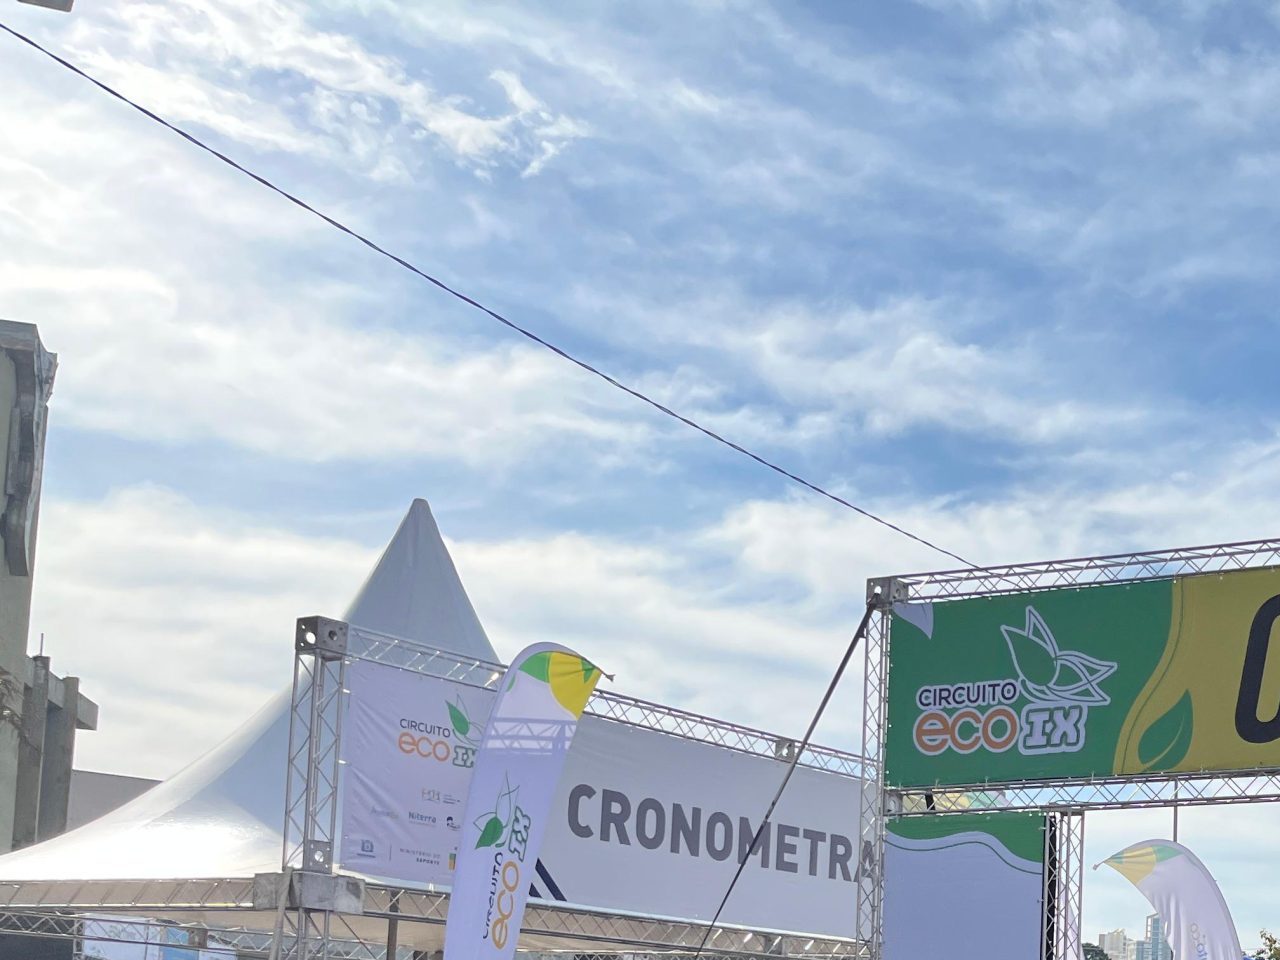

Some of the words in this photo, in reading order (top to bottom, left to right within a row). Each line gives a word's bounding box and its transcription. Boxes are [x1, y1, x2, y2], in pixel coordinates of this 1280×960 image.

[918, 682, 1017, 707] CIRCUITO
[400, 718, 450, 738] CIRCUITO
[915, 708, 1018, 752] eco
[398, 732, 450, 762] eco
[408, 811, 437, 824] Niterra
